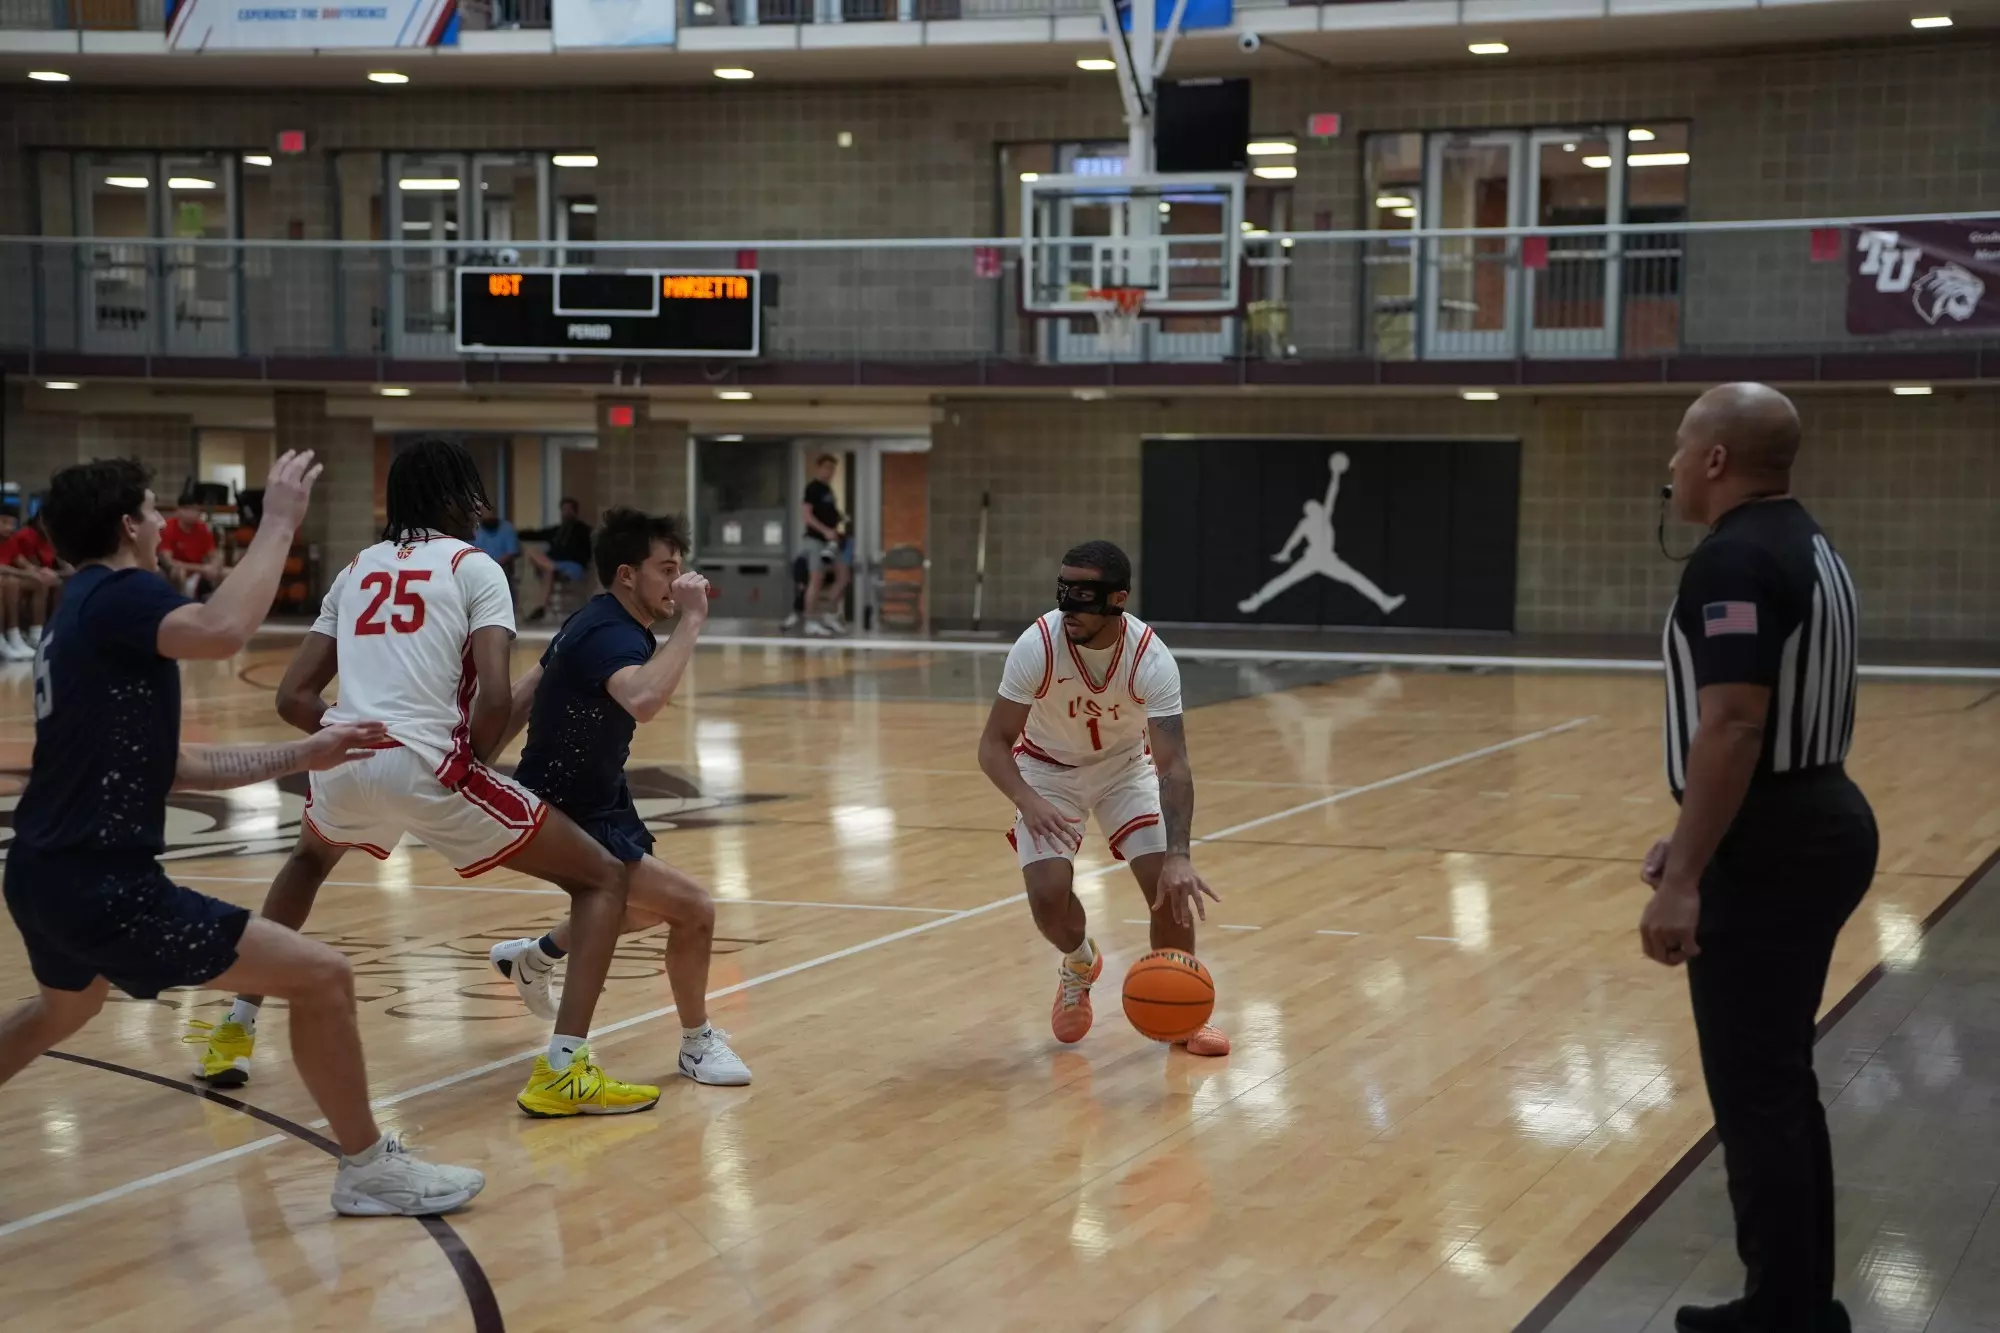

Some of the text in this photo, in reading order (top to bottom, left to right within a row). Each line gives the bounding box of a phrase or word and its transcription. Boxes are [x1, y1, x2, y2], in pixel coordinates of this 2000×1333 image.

[237, 8, 297, 20] EXPERIENCE
[302, 8, 318, 19] THE
[1857, 230, 1922, 293] TU
[489, 274, 523, 296] UST
[567, 323, 612, 341] PERIOD
[354, 569, 433, 636] 25
[1086, 717, 1103, 751] 1
